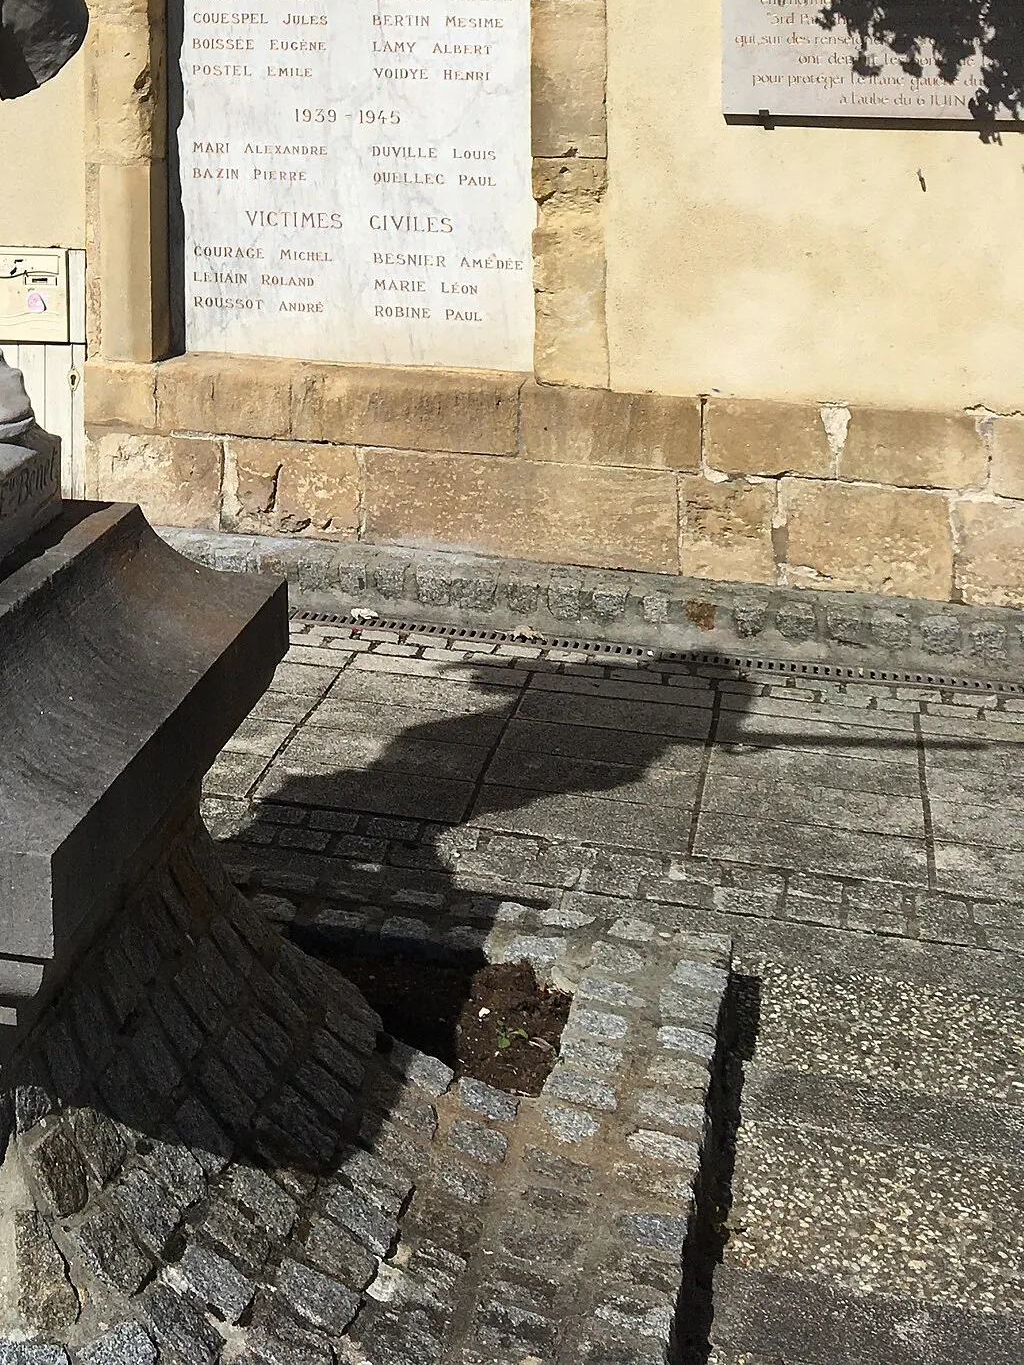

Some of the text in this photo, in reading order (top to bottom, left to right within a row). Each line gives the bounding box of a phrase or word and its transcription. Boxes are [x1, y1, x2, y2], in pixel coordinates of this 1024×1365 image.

[193, 12, 328, 26] COUESPEL JULES
[372, 14, 504, 29] BERTIN MESIME
[787, 31, 811, 44] des
[373, 41, 492, 55] LAMY ALBERT
[192, 64, 313, 77] POSTEL EMILE
[373, 68, 490, 81] VOIDYE HENRI
[752, 74, 784, 87] pour
[894, 92, 912, 105] du
[930, 94, 967, 107] JUIN
[295, 108, 337, 123] 1939
[358, 109, 401, 125] 1945
[192, 141, 328, 156] MARI ALEXANDRE
[371, 145, 496, 161] DUVILLE LOUIS
[192, 167, 307, 182] BAZIN PIERRE
[458, 174, 497, 187] PAUL
[245, 210, 454, 234] VICTIMES CIVILES
[193, 245, 333, 262] COURAGE MICHEL
[373, 252, 447, 268] BESNIER
[261, 274, 315, 287] ROLAND
[374, 278, 479, 295] MARIE LÉON
[193, 295, 324, 313] ROUSSOT ANDRÉ
[374, 305, 483, 322] ROBINE PAUL
